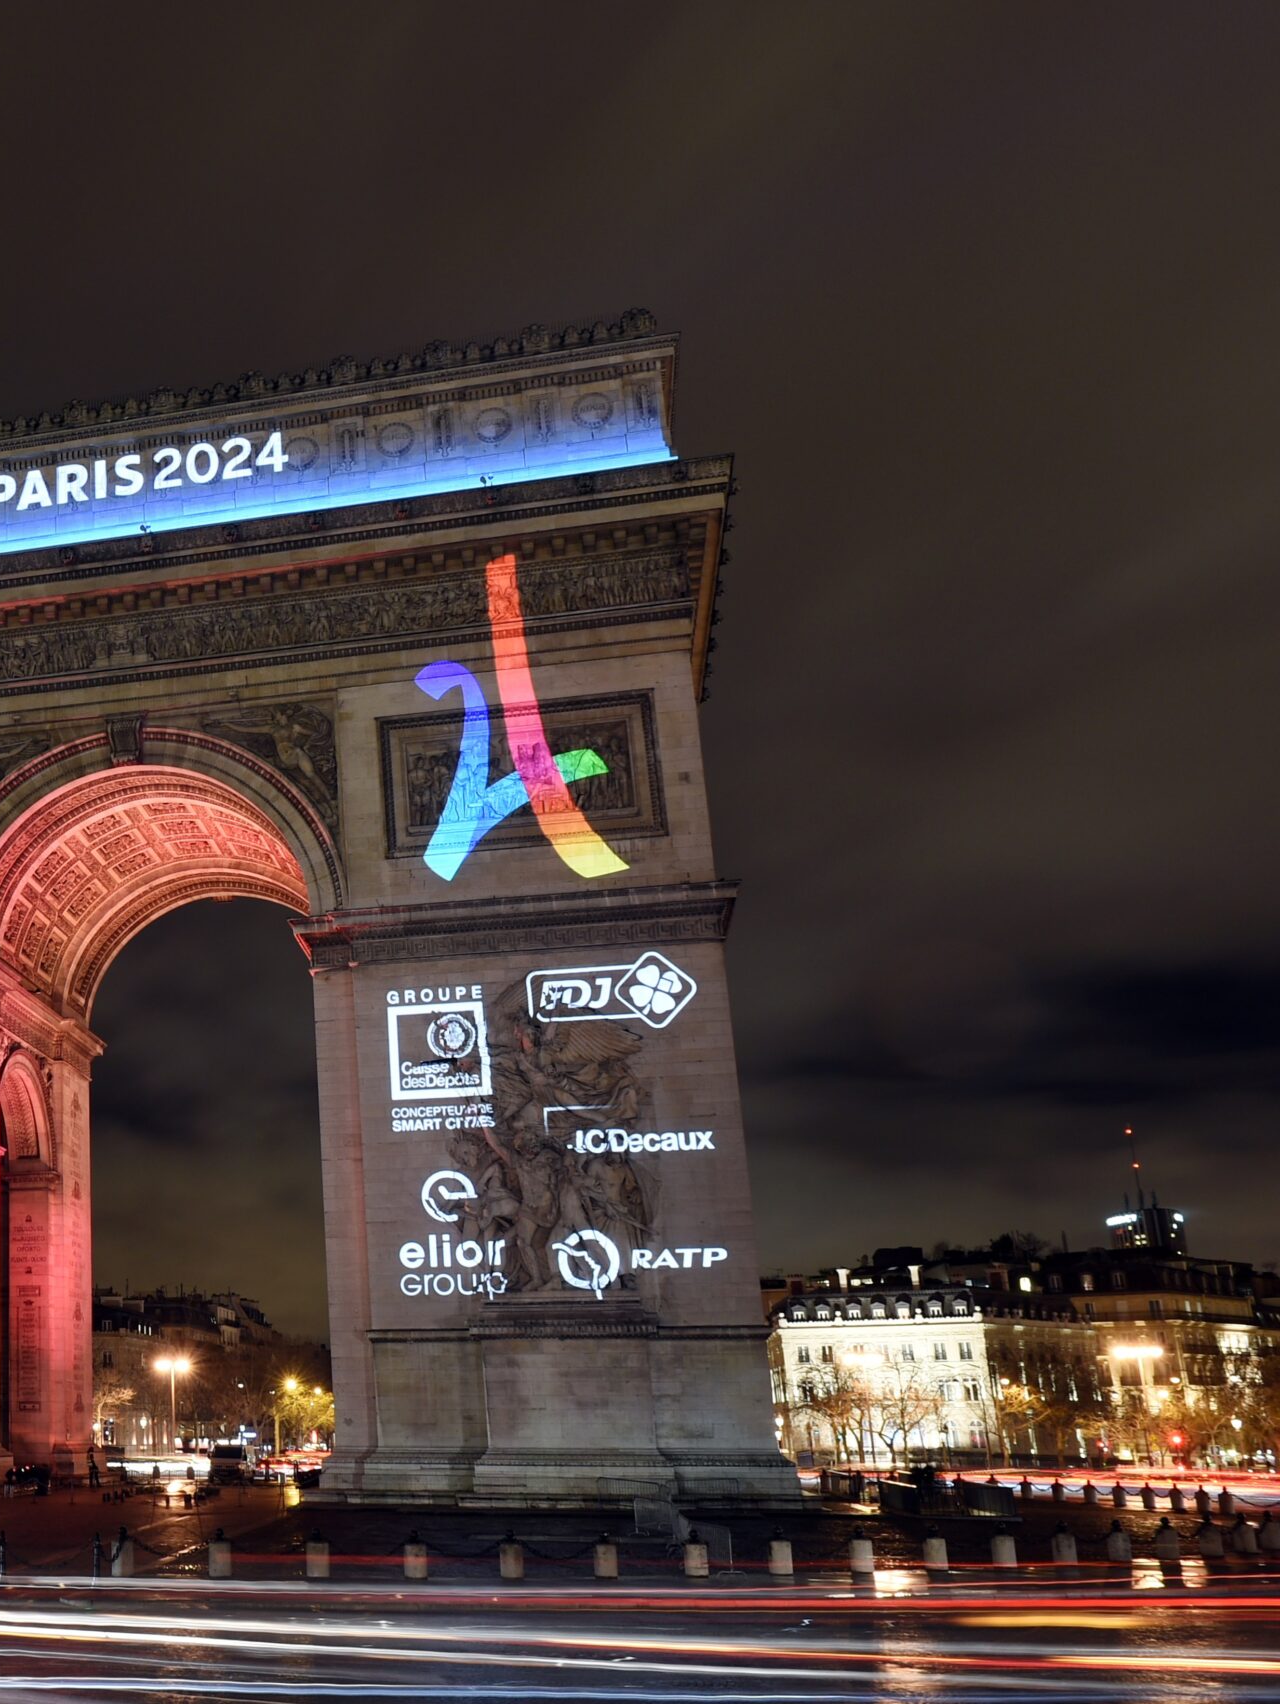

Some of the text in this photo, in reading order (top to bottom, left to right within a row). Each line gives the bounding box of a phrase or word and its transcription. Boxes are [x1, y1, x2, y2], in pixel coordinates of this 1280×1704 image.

[386, 985, 483, 1004] GROUPE
[540, 977, 612, 1010] FDJ
[401, 1061, 450, 1075] Caisse
[392, 1118, 442, 1132] SMART
[399, 1233, 506, 1269] elior
[631, 1247, 728, 1270] RATP
